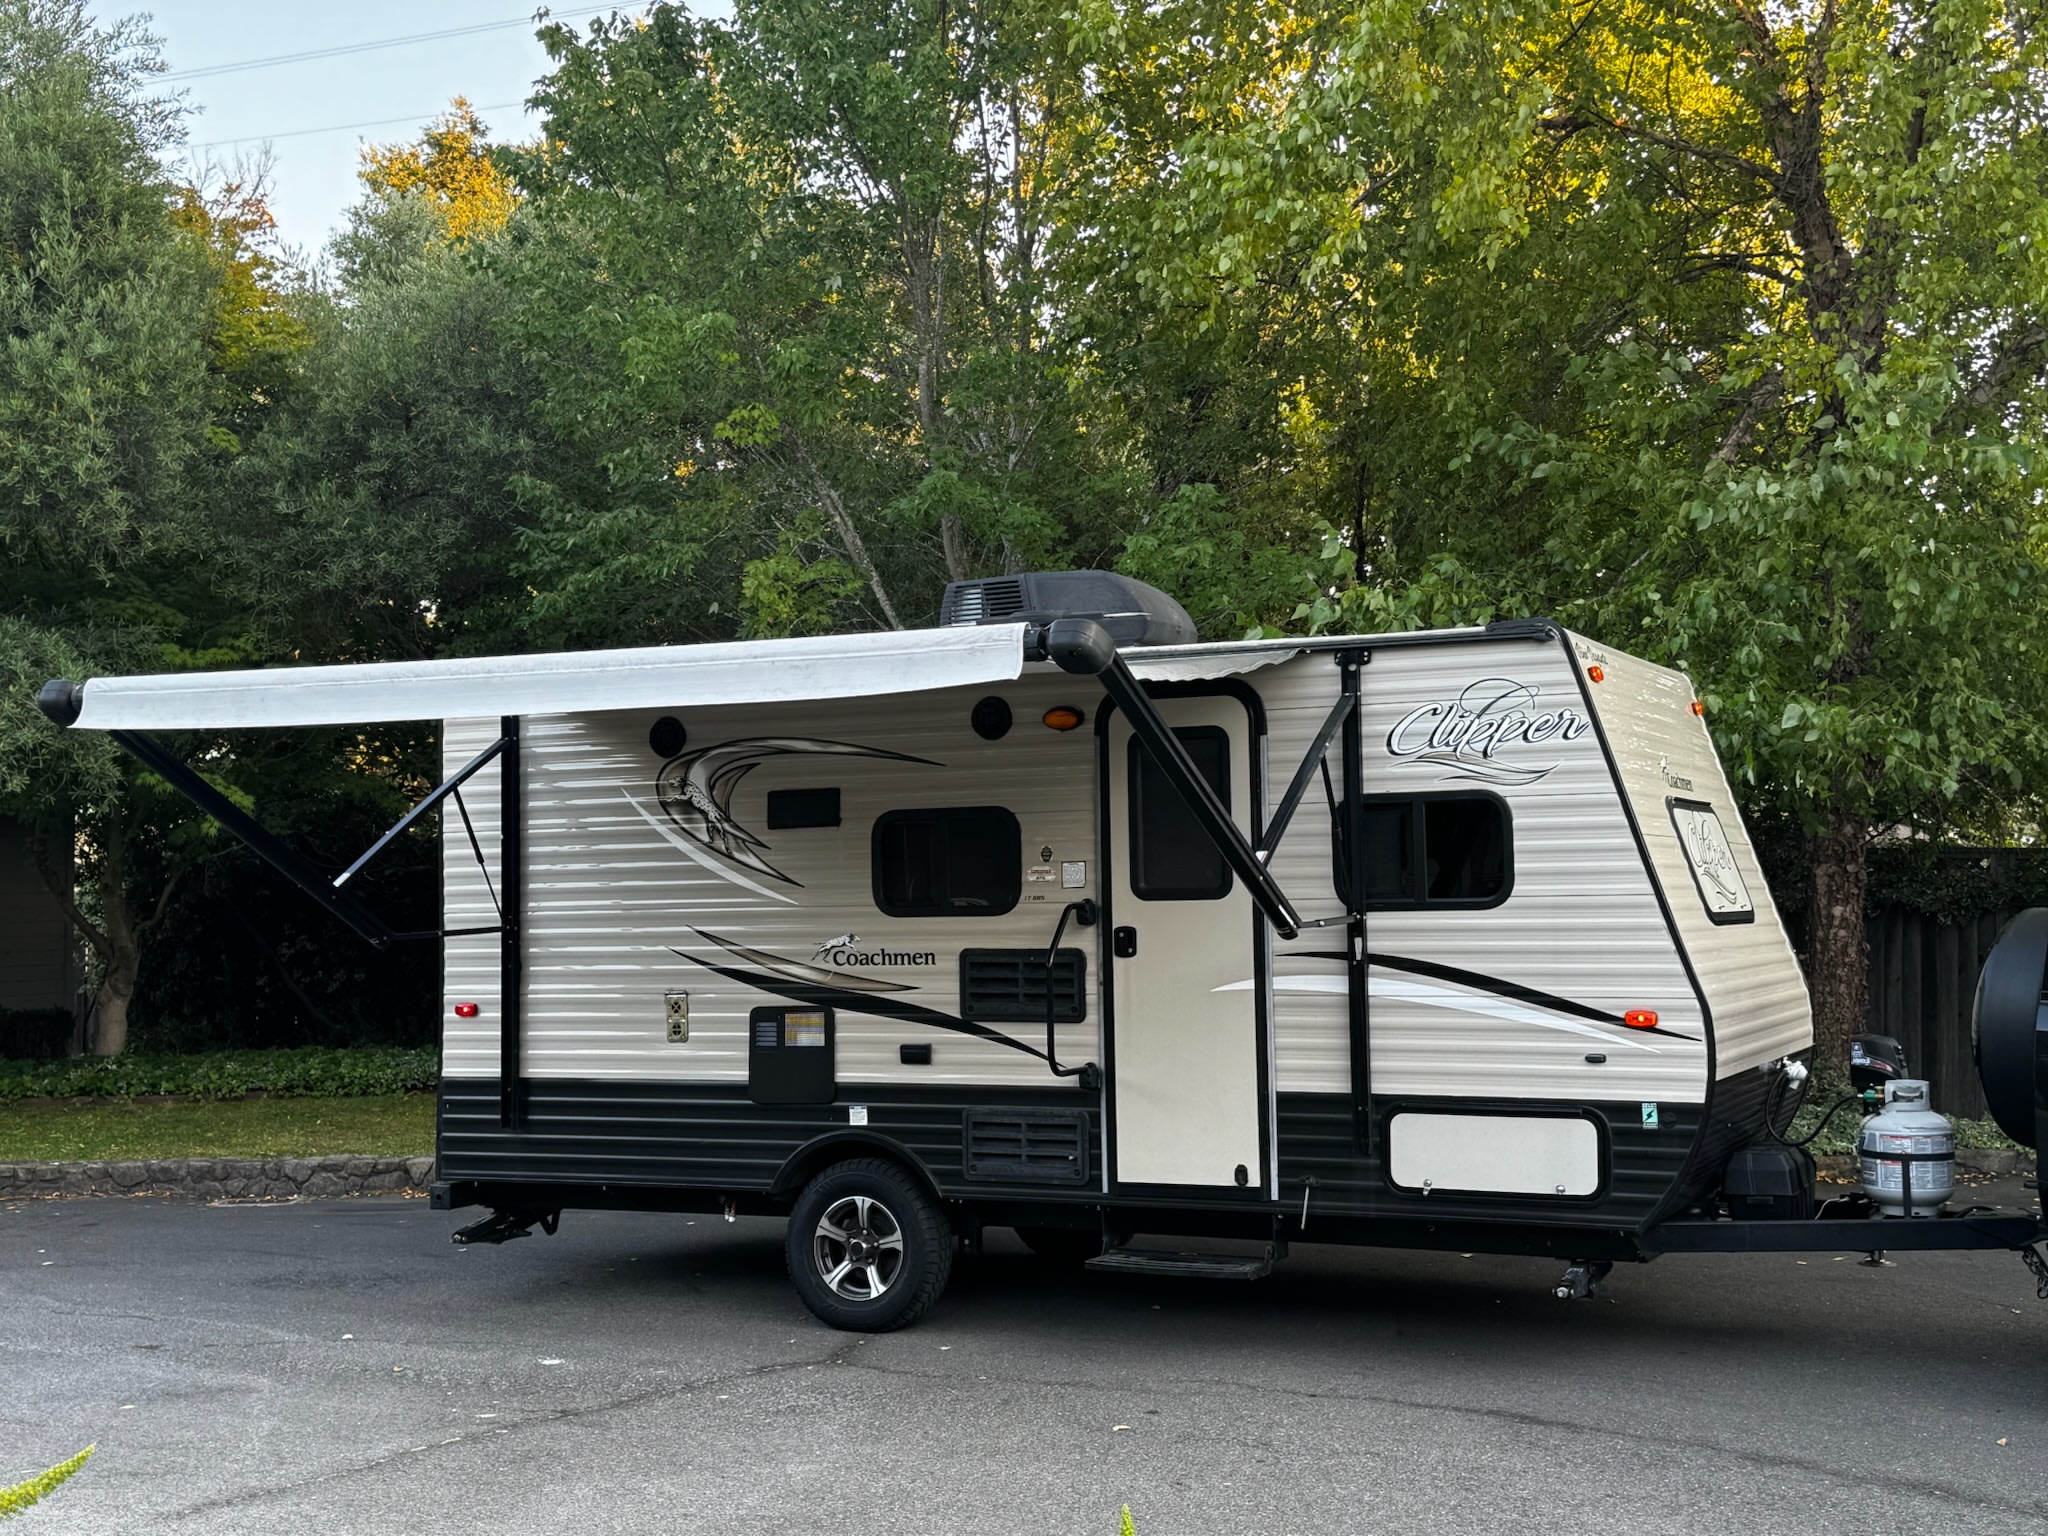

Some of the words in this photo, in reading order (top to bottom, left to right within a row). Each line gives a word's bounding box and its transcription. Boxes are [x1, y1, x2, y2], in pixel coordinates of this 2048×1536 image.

[1386, 678, 1590, 760] Clipper
[1666, 773, 1694, 792] Coachmen
[1687, 818, 1732, 878] Clipper
[832, 948, 936, 967] Coachmen
